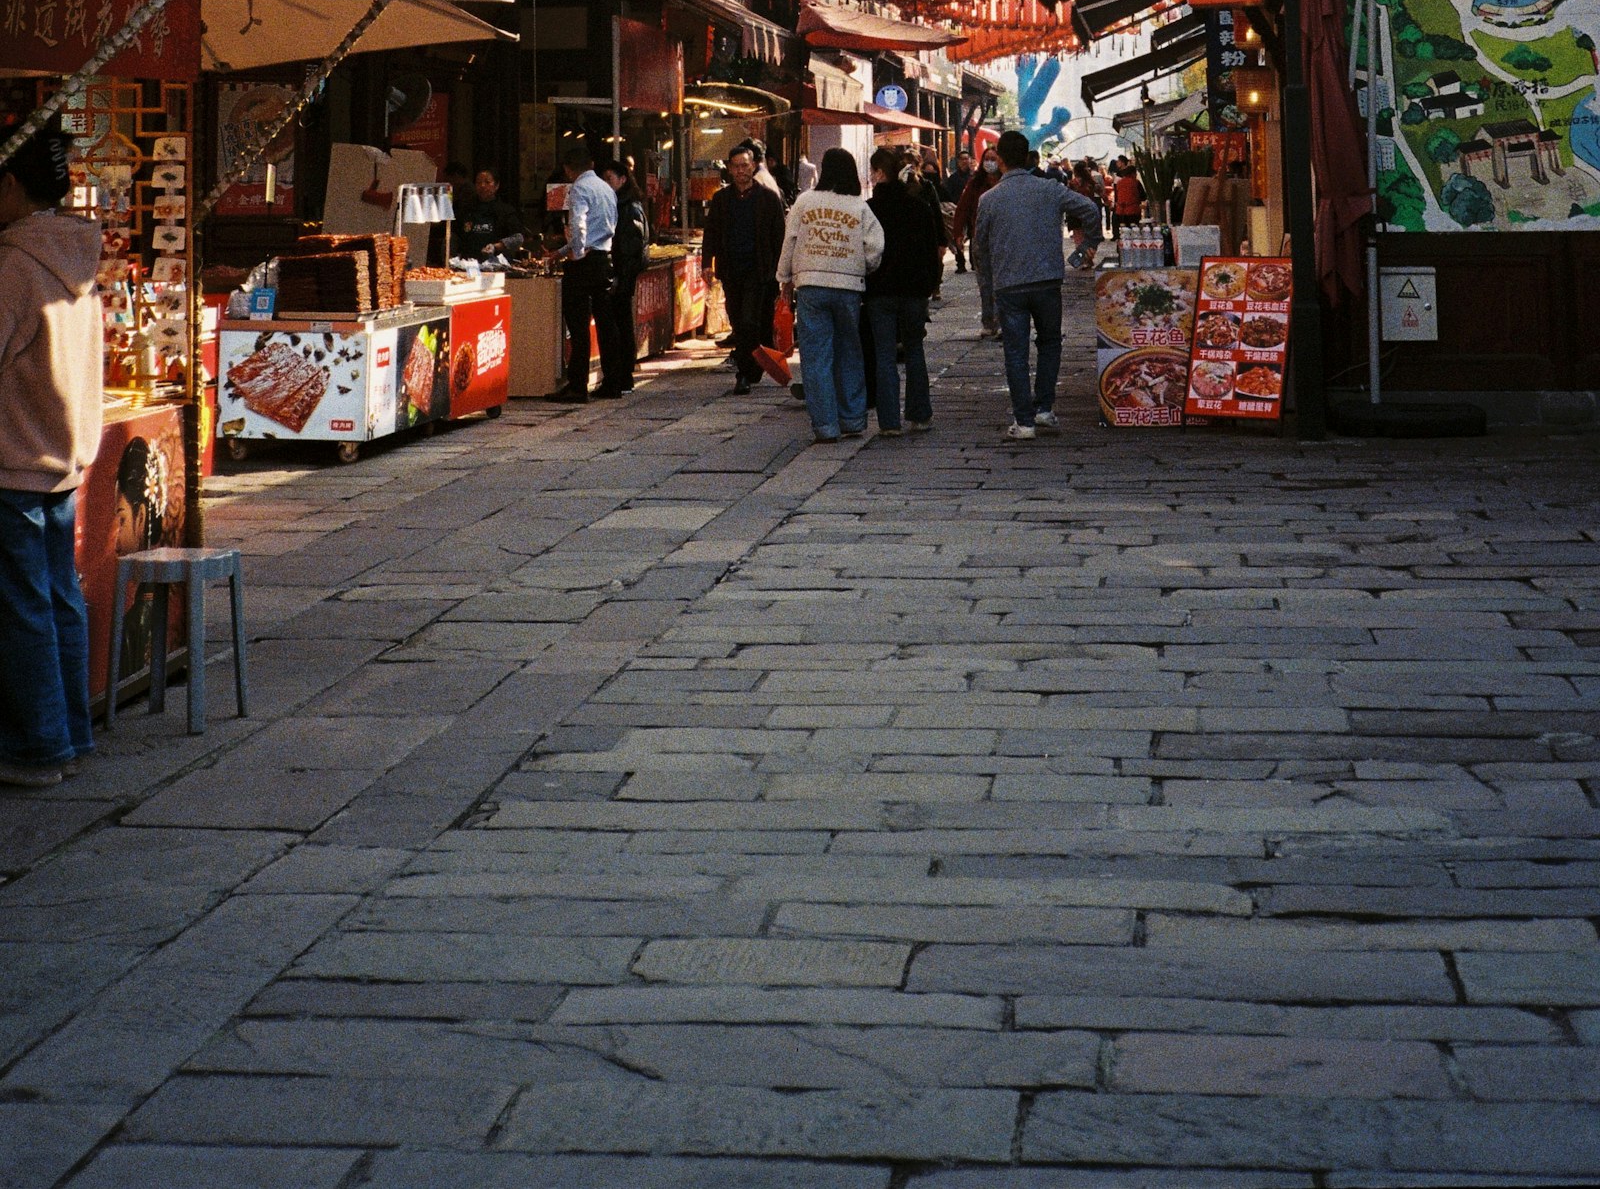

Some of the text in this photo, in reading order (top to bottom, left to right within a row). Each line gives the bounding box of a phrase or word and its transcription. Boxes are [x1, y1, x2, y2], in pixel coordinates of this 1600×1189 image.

[801, 208, 860, 229] CHINESE
[808, 226, 850, 244] Myths
[1209, 300, 1234, 310] 豆花鱼
[1246, 301, 1289, 312] 豆花毛血旺
[1131, 328, 1185, 347] 豆花鱼
[1114, 406, 1209, 427] 豆花毛血
